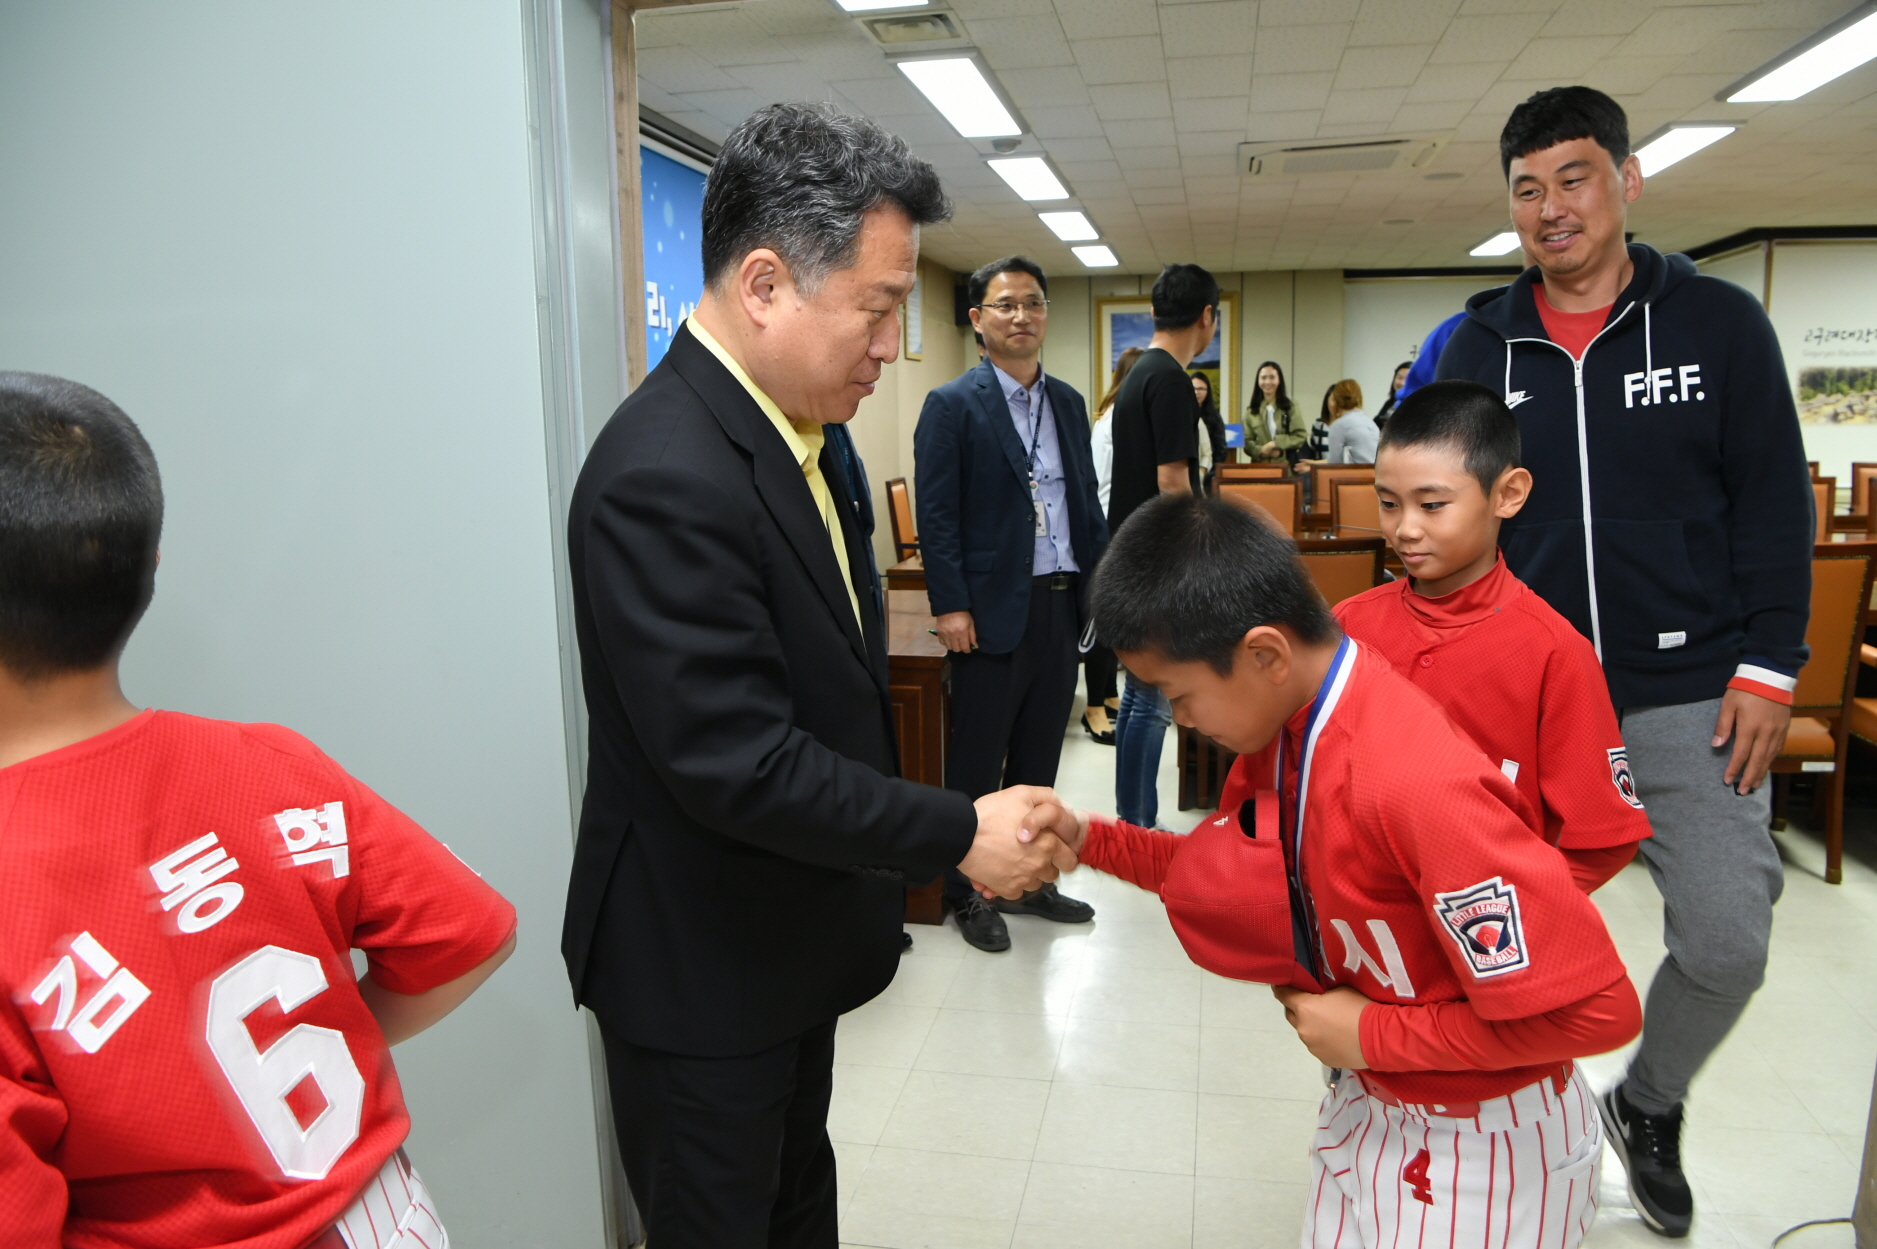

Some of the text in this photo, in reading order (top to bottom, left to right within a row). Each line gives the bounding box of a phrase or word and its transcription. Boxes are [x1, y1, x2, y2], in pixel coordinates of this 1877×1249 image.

[1451, 902, 1509, 927] LITTLE LEAGUE
[1475, 945, 1518, 966] BASEBALL
[206, 944, 366, 1180] 6
[1403, 1148, 1434, 1206] 4
